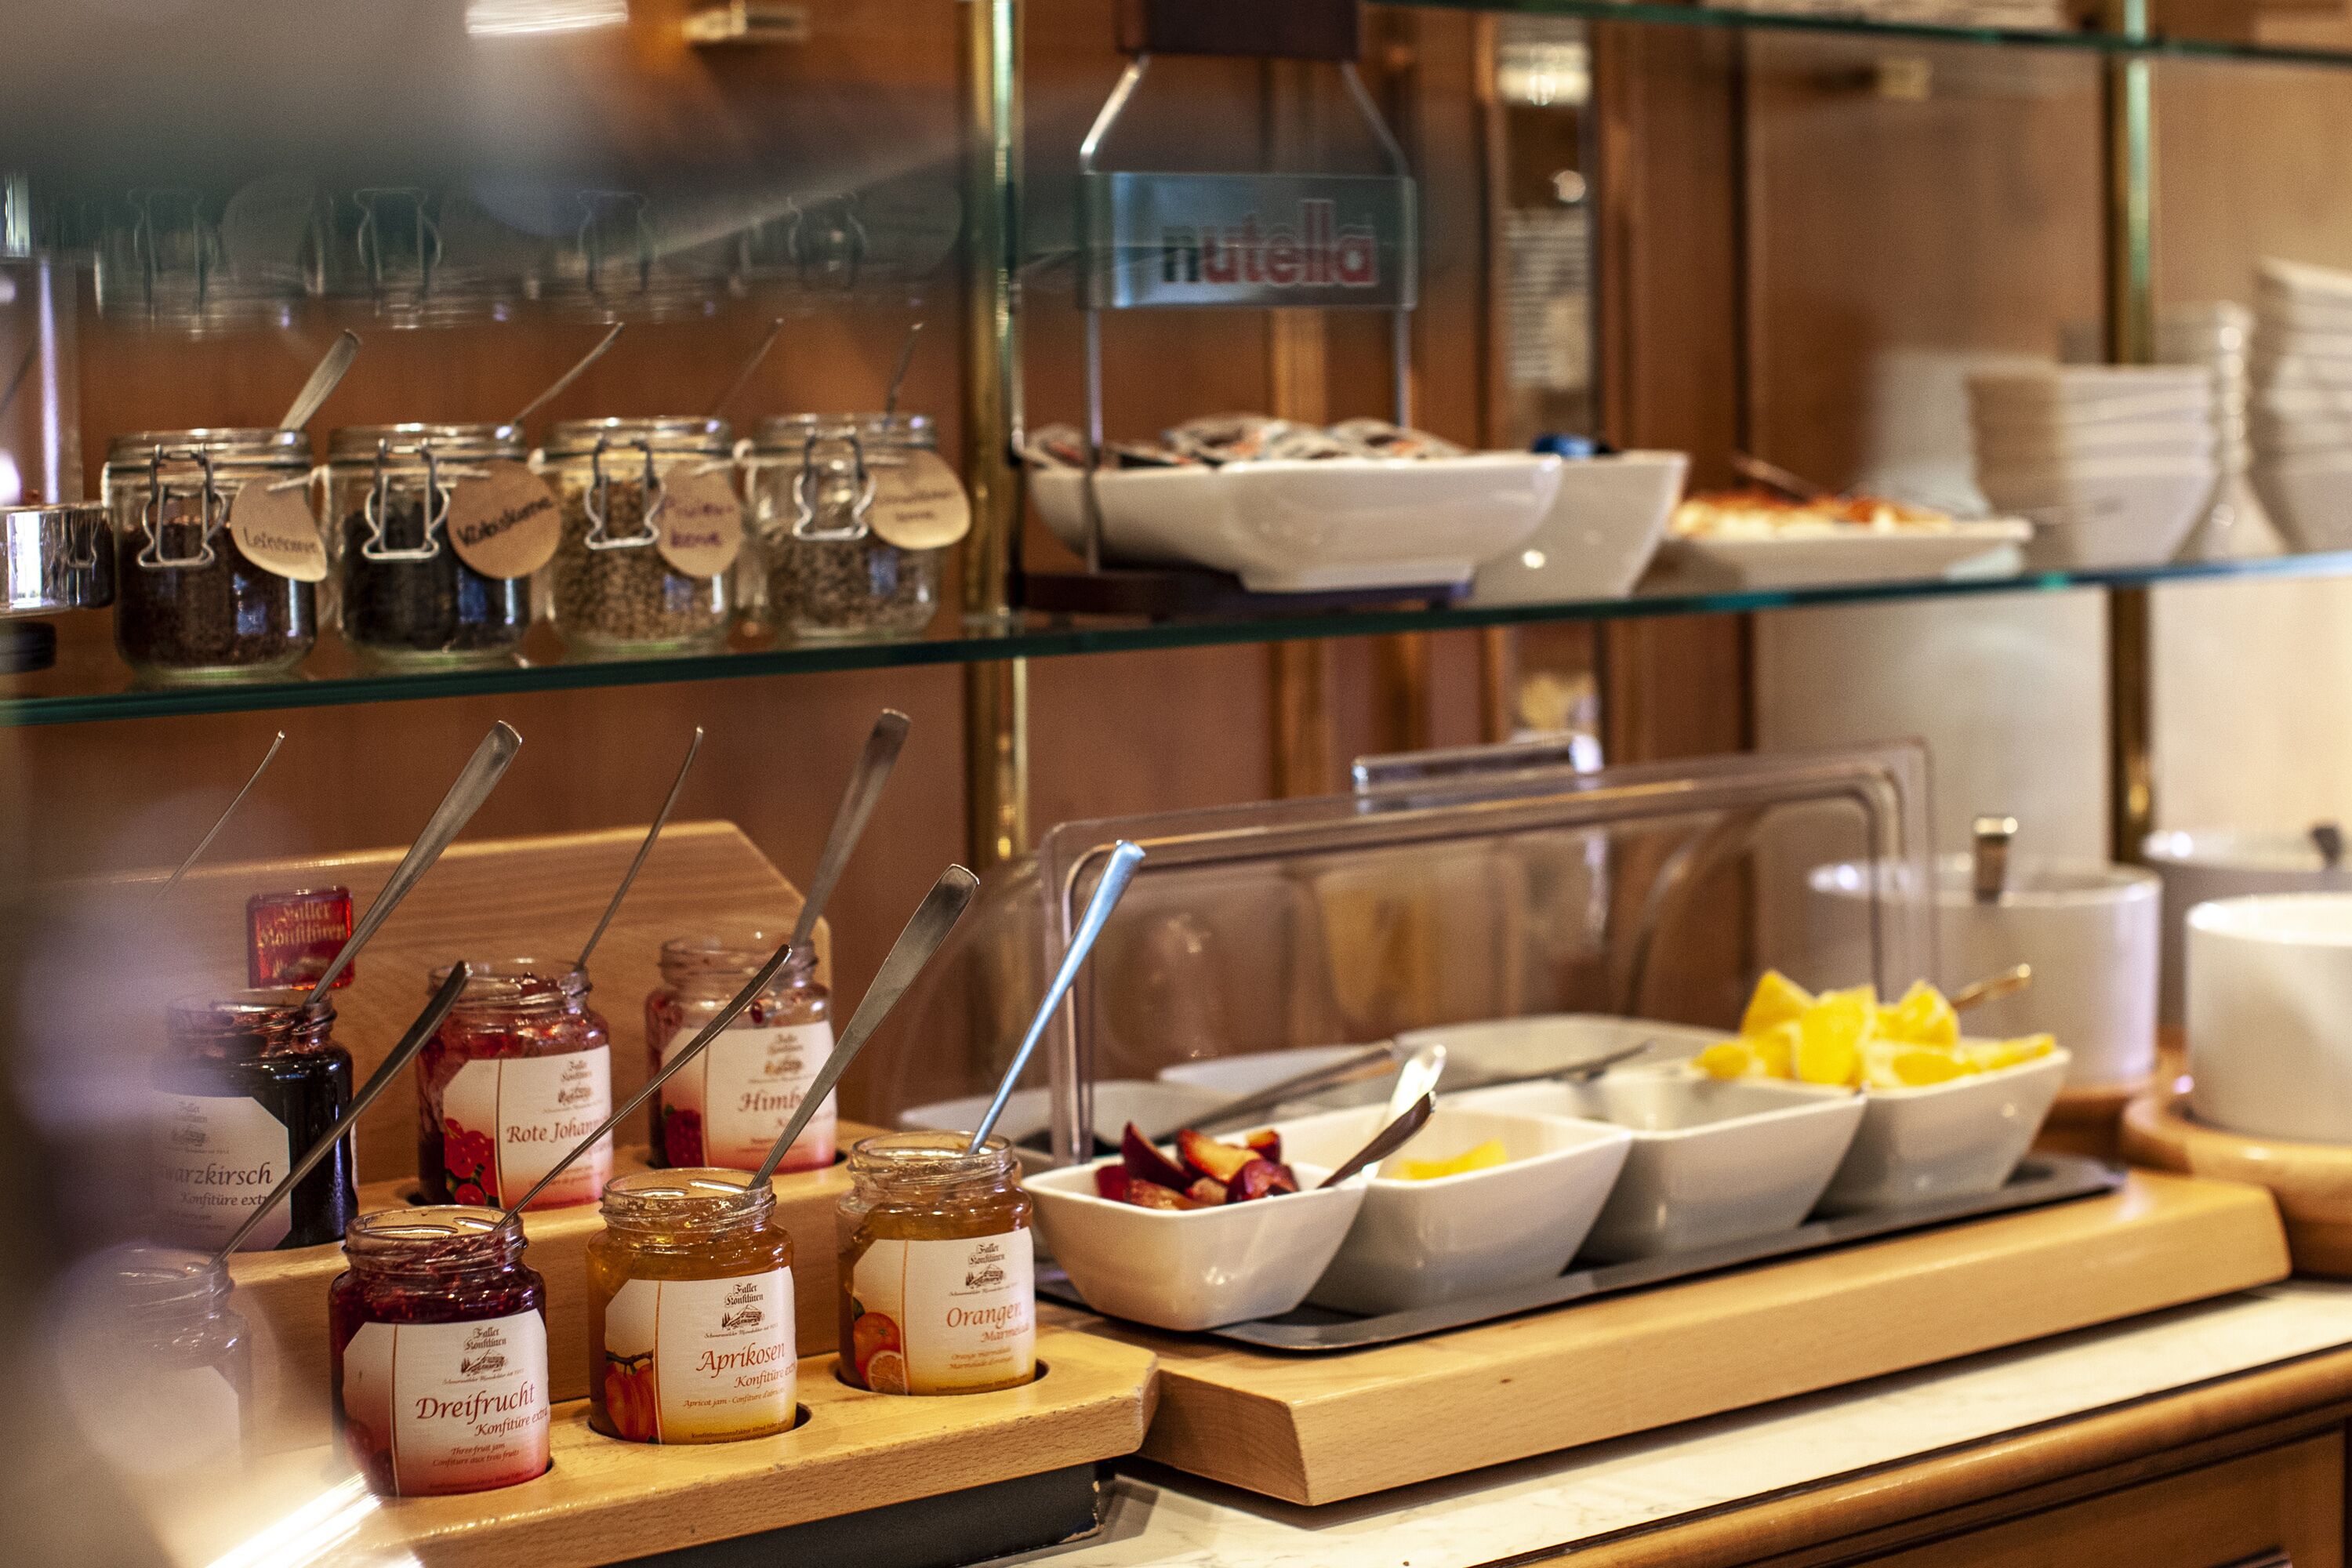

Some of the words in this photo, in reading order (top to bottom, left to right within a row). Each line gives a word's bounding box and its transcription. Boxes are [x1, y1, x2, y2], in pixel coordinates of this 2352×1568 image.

[1161, 198, 1377, 286] nutella
[738, 1086, 808, 1112] Himb
[506, 1124, 547, 1144] Rote
[733, 1283, 758, 1294] Faller
[724, 1294, 764, 1307] Konfitüren
[946, 1301, 1022, 1329] Orangen
[473, 1327, 499, 1339] Faller
[464, 1338, 506, 1351] Konfitüren
[695, 1341, 785, 1378] Aprikosen
[734, 1367, 784, 1389] Konfitüre
[416, 1381, 535, 1425] Dreifrucht
[683, 1399, 712, 1409] Apricot
[711, 1398, 728, 1408] jam
[474, 1414, 531, 1437] Konfitüre
